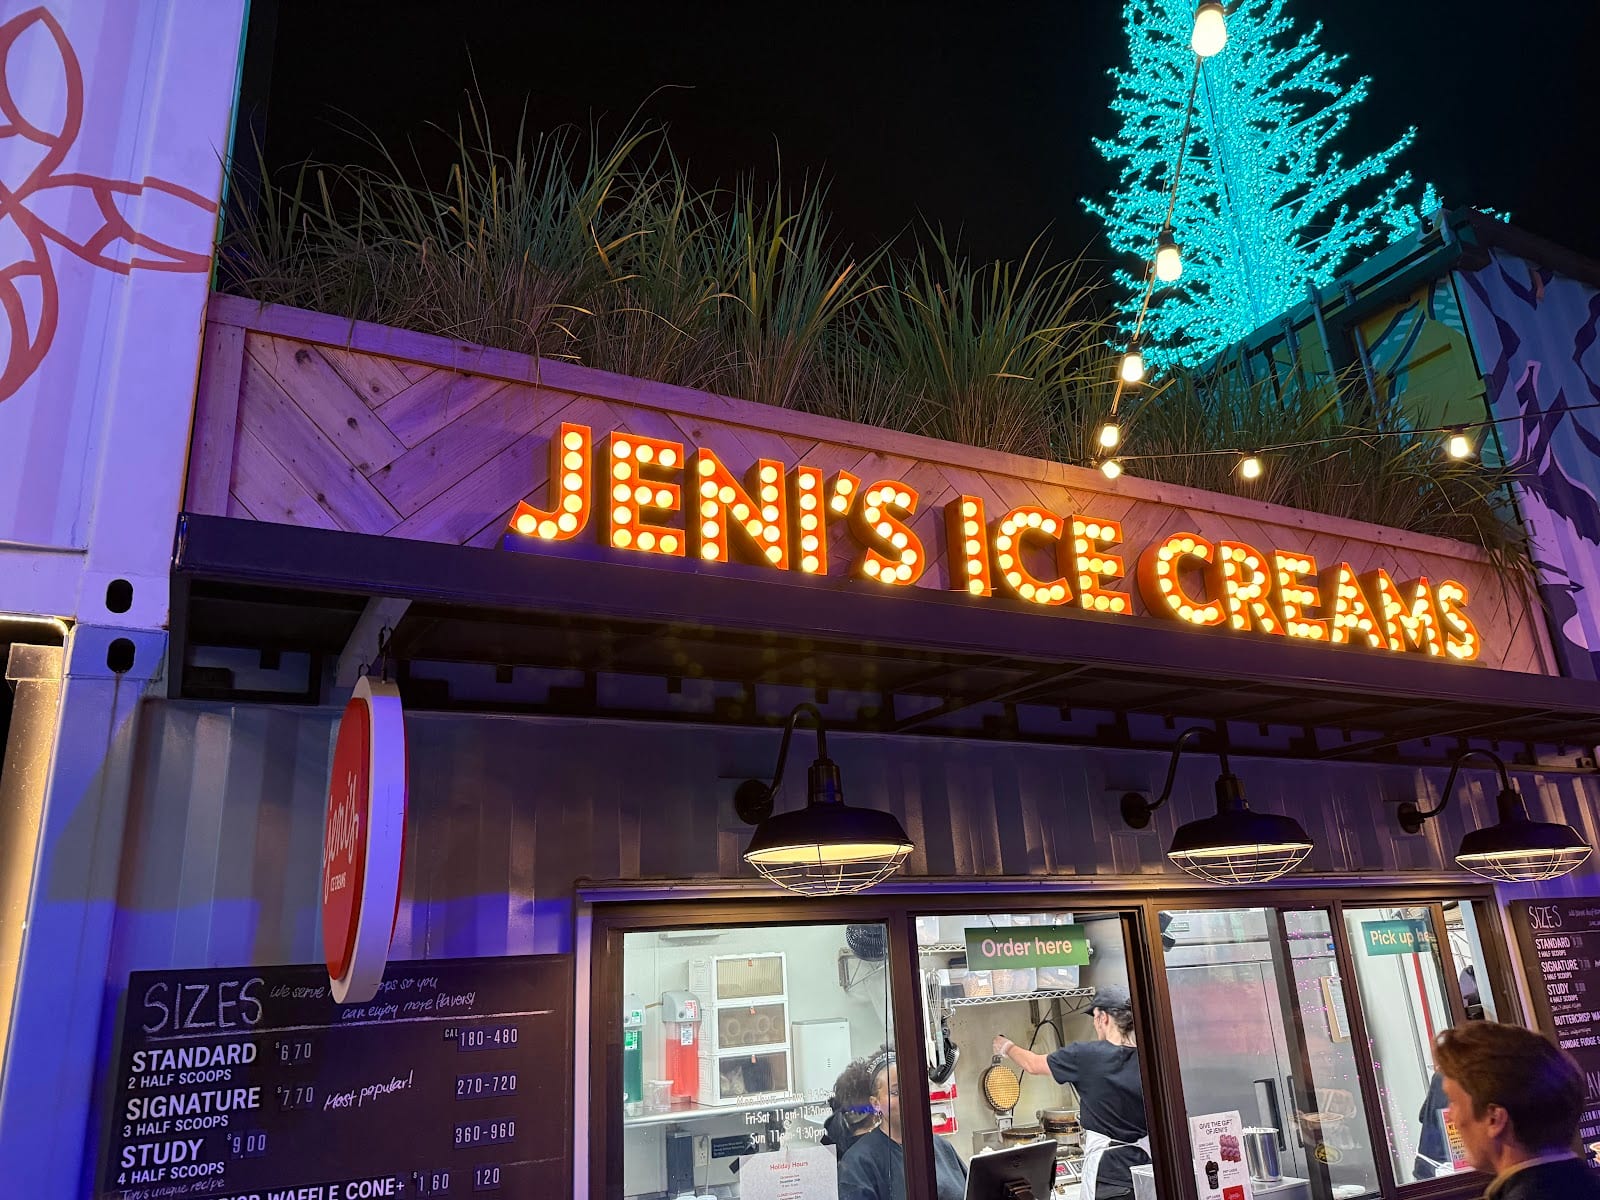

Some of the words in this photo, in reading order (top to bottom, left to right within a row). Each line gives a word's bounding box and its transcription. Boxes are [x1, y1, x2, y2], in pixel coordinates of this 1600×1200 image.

[508, 421, 926, 586] JENI'S
[944, 495, 1132, 616] ICE
[1138, 532, 1481, 661] CREAMS
[1528, 904, 1563, 929] SIZES
[981, 938, 1030, 958] Order
[1035, 937, 1073, 955] here
[1370, 930, 1397, 946] Pick
[1399, 931, 1415, 947] up
[1535, 937, 1570, 950] STANDARD
[1541, 959, 1579, 973] SIGNATURE
[270, 985, 290, 999] We
[292, 986, 323, 999] serve
[400, 978, 415, 990] so
[417, 976, 438, 995] you
[1547, 982, 1570, 996] STUDY
[142, 978, 265, 1034] SIZES
[342, 1007, 365, 1020] can
[368, 1002, 399, 1021] enjoy
[404, 998, 433, 1013] more
[444, 1028, 459, 1038] CAL
[460, 1028, 518, 1047] 180-480
[131, 1042, 257, 1073] STANDARD
[128, 1077, 136, 1090] 2
[140, 1073, 175, 1089] HALF
[178, 1069, 232, 1085] SCOOPS
[324, 1092, 357, 1111] Most
[358, 1069, 414, 1107] popular!
[457, 1075, 517, 1095] 270-720
[126, 1087, 261, 1121] SIGNATURE
[123, 1125, 132, 1138] 3
[136, 1121, 171, 1136] HALF
[174, 1115, 229, 1131] SCOOPS
[745, 1112, 770, 1125] Fri-Sat
[1199, 1122, 1211, 1130] GIVE
[1222, 1119, 1233, 1127] GIFT
[455, 1121, 515, 1143] 360-960
[750, 1132, 766, 1145] Sun
[121, 1138, 204, 1169] STUDY
[117, 1173, 126, 1185] 4
[131, 1168, 166, 1184] HALF
[170, 1161, 225, 1179] SCOOPS
[769, 1162, 791, 1170] Holiday
[792, 1160, 809, 1168] Hours
[476, 1167, 500, 1186] 120
[151, 1183, 188, 1200] unique
[190, 1176, 225, 1192] recipe
